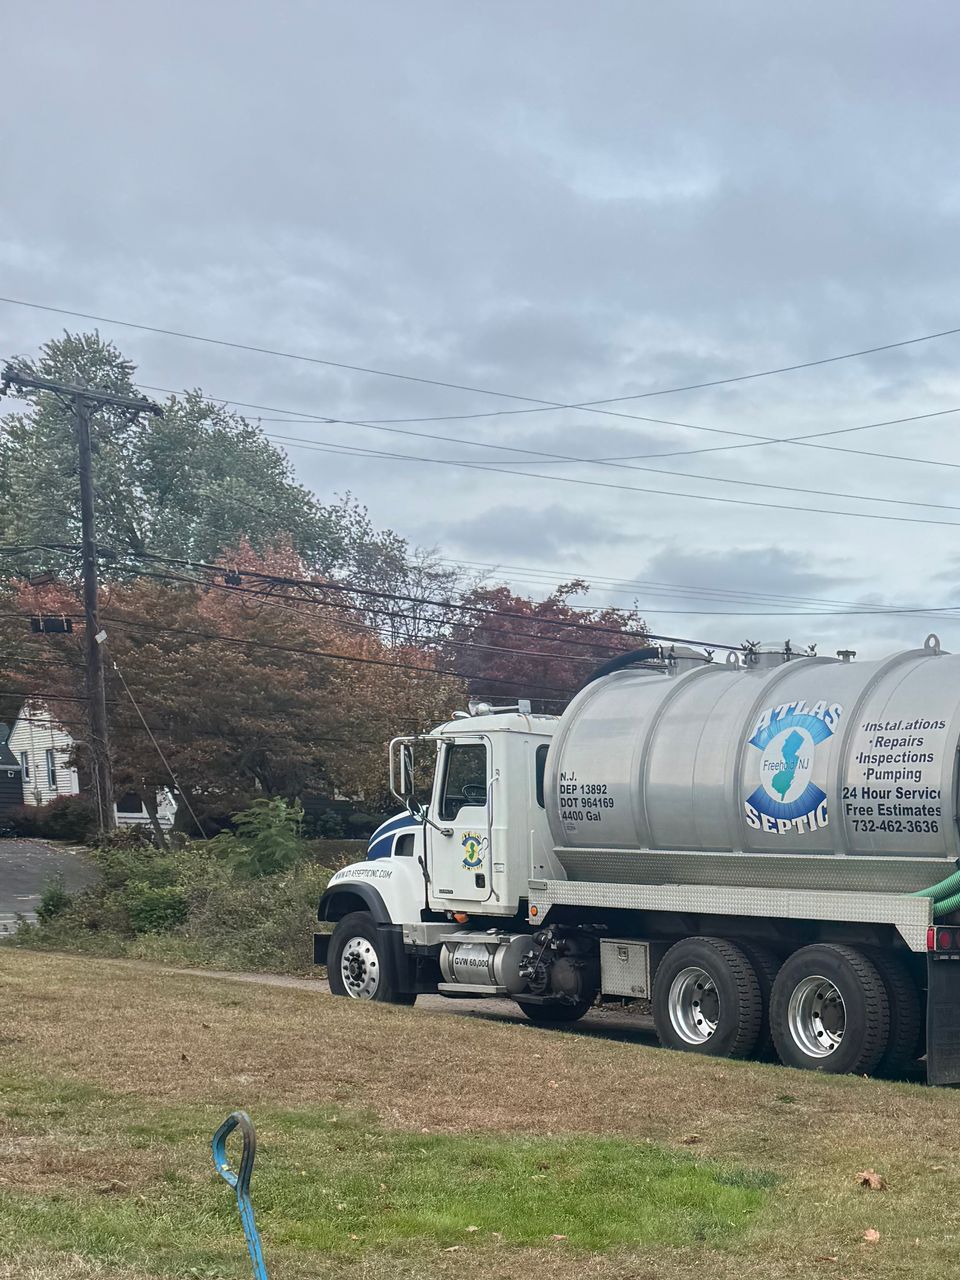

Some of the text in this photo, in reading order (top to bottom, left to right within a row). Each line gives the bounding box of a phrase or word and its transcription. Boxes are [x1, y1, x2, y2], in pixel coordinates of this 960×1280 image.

[747, 700, 843, 741] ATLAS
[864, 718, 946, 732] Instalations
[874, 735, 925, 750] Repairs
[798, 758, 810, 770] NJ
[858, 751, 934, 766] Inspections
[560, 771, 577, 781] N.J.
[866, 767, 922, 783] Pumping
[560, 784, 607, 795] DEP 13892
[842, 786, 857, 800] 24
[861, 786, 892, 800] Hour
[560, 797, 614, 808] DOT 964169
[562, 810, 602, 821] 4400 Gal
[744, 798, 829, 835] SEPTIC
[845, 803, 942, 817] Free Estimates
[852, 819, 939, 833] 732-462-3636
